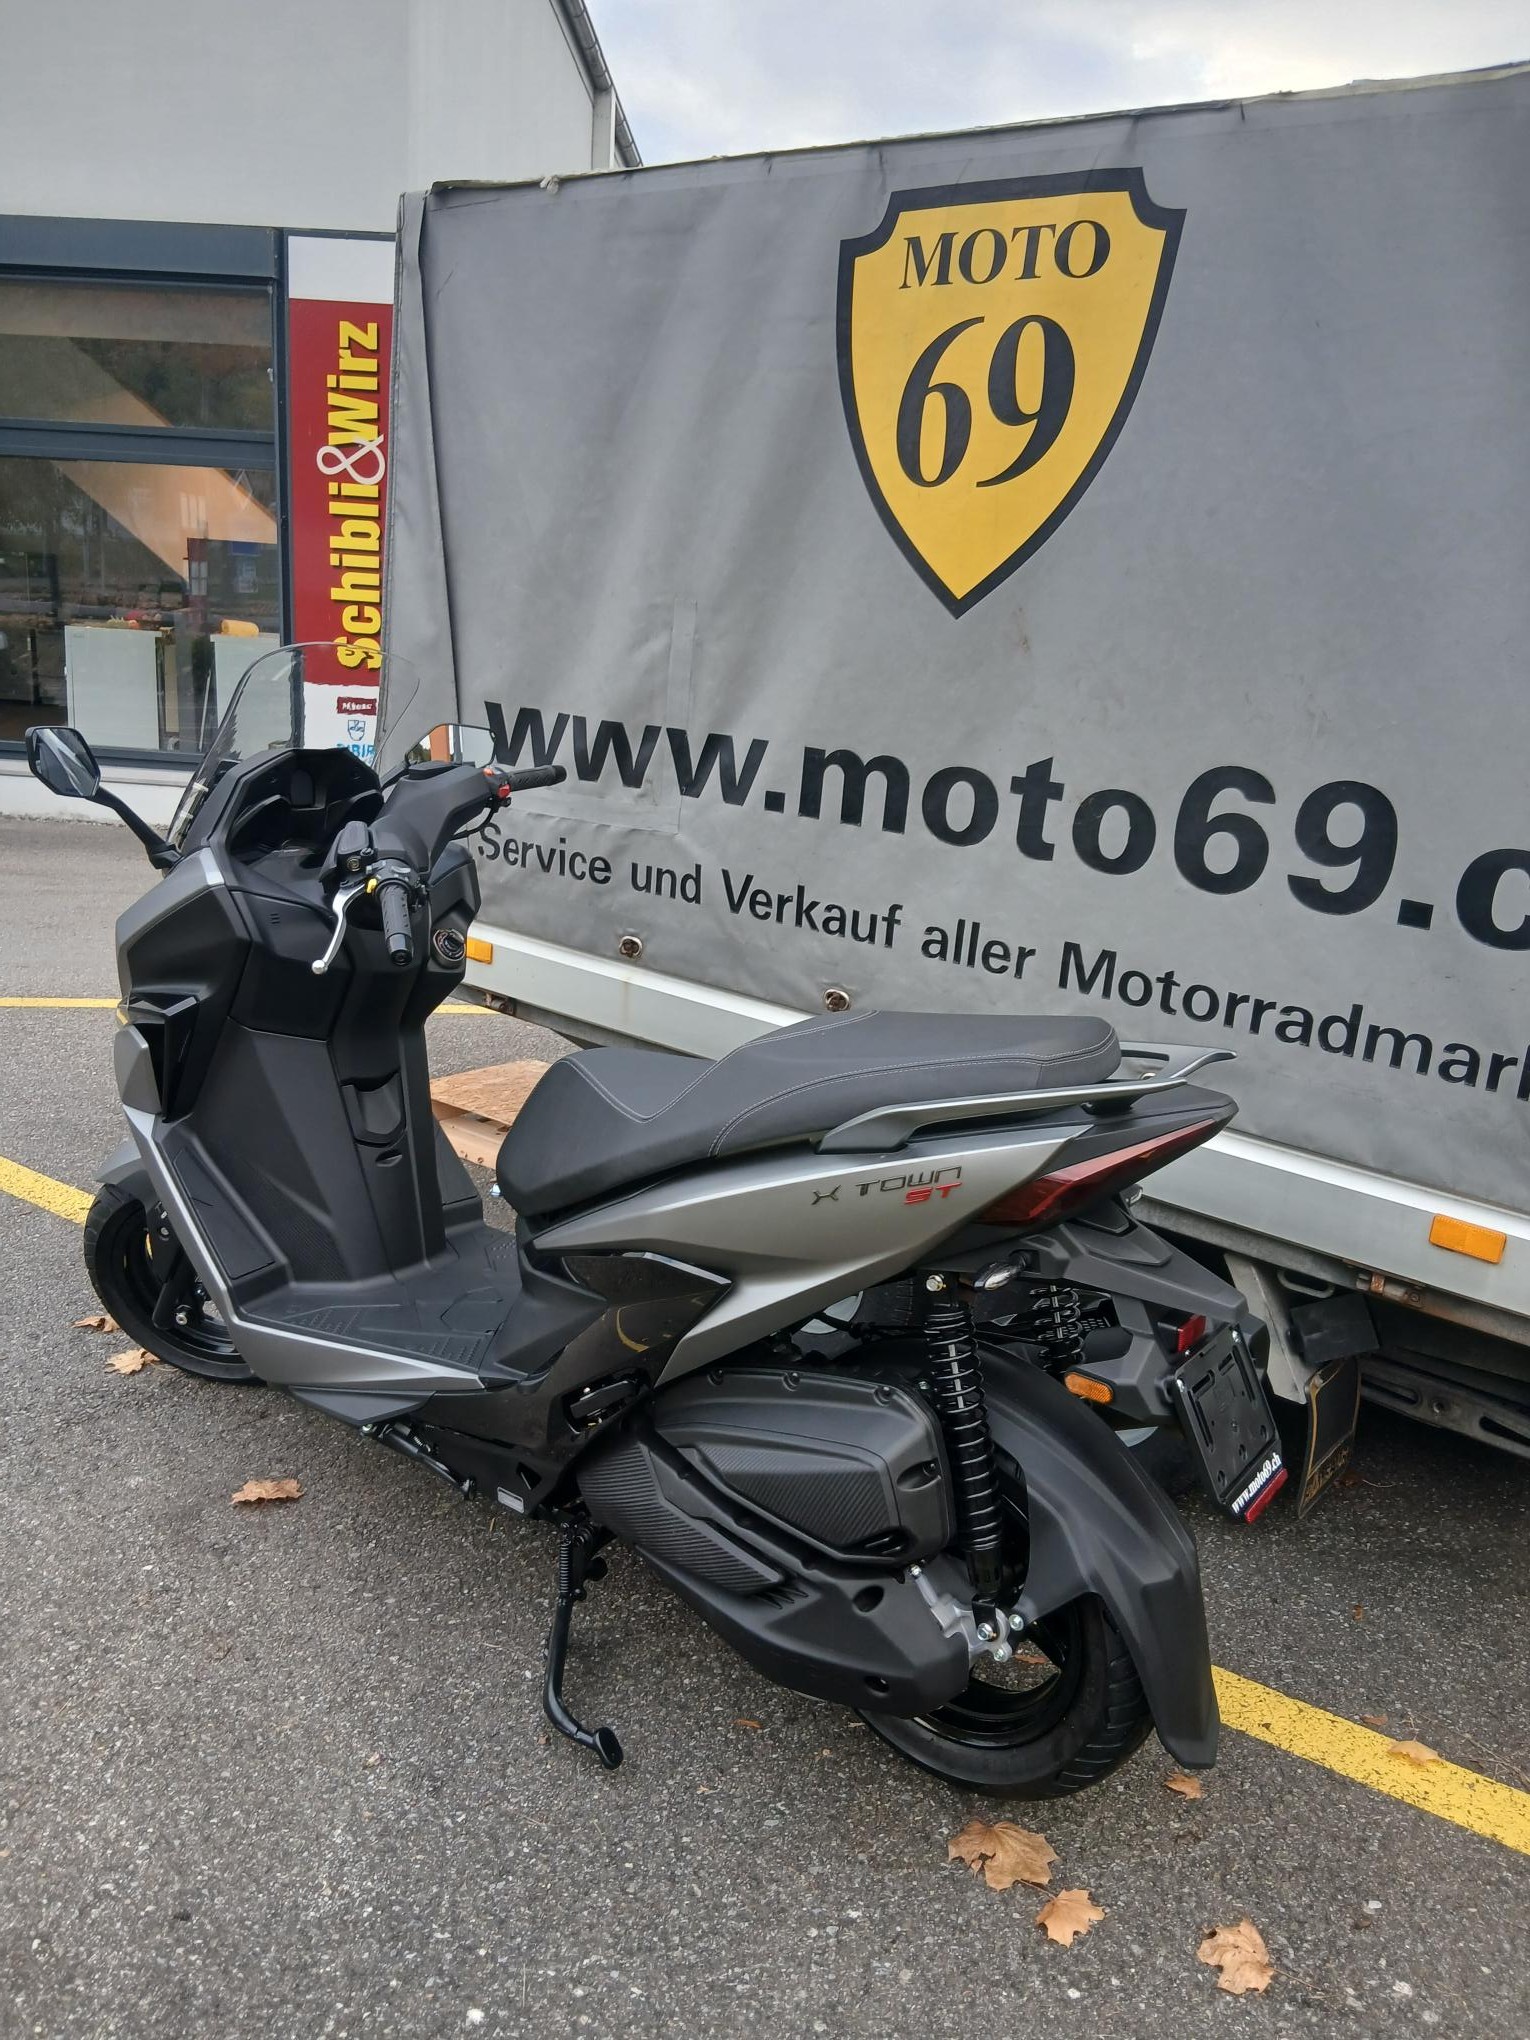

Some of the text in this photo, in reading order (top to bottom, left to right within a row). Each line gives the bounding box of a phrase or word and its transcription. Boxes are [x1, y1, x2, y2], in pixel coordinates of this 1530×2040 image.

[899, 220, 1111, 290] MOTO
[896, 314, 1076, 488] 69
[484, 701, 1530, 951] www.moto69.c
[478, 822, 612, 885] Service
[631, 861, 702, 905] und
[721, 868, 904, 949] Verkauf
[920, 918, 1037, 980] aller
[811, 1184, 842, 1205] X
[904, 1182, 962, 1205] ST
[1231, 1452, 1282, 1514] www.moto69.ch
